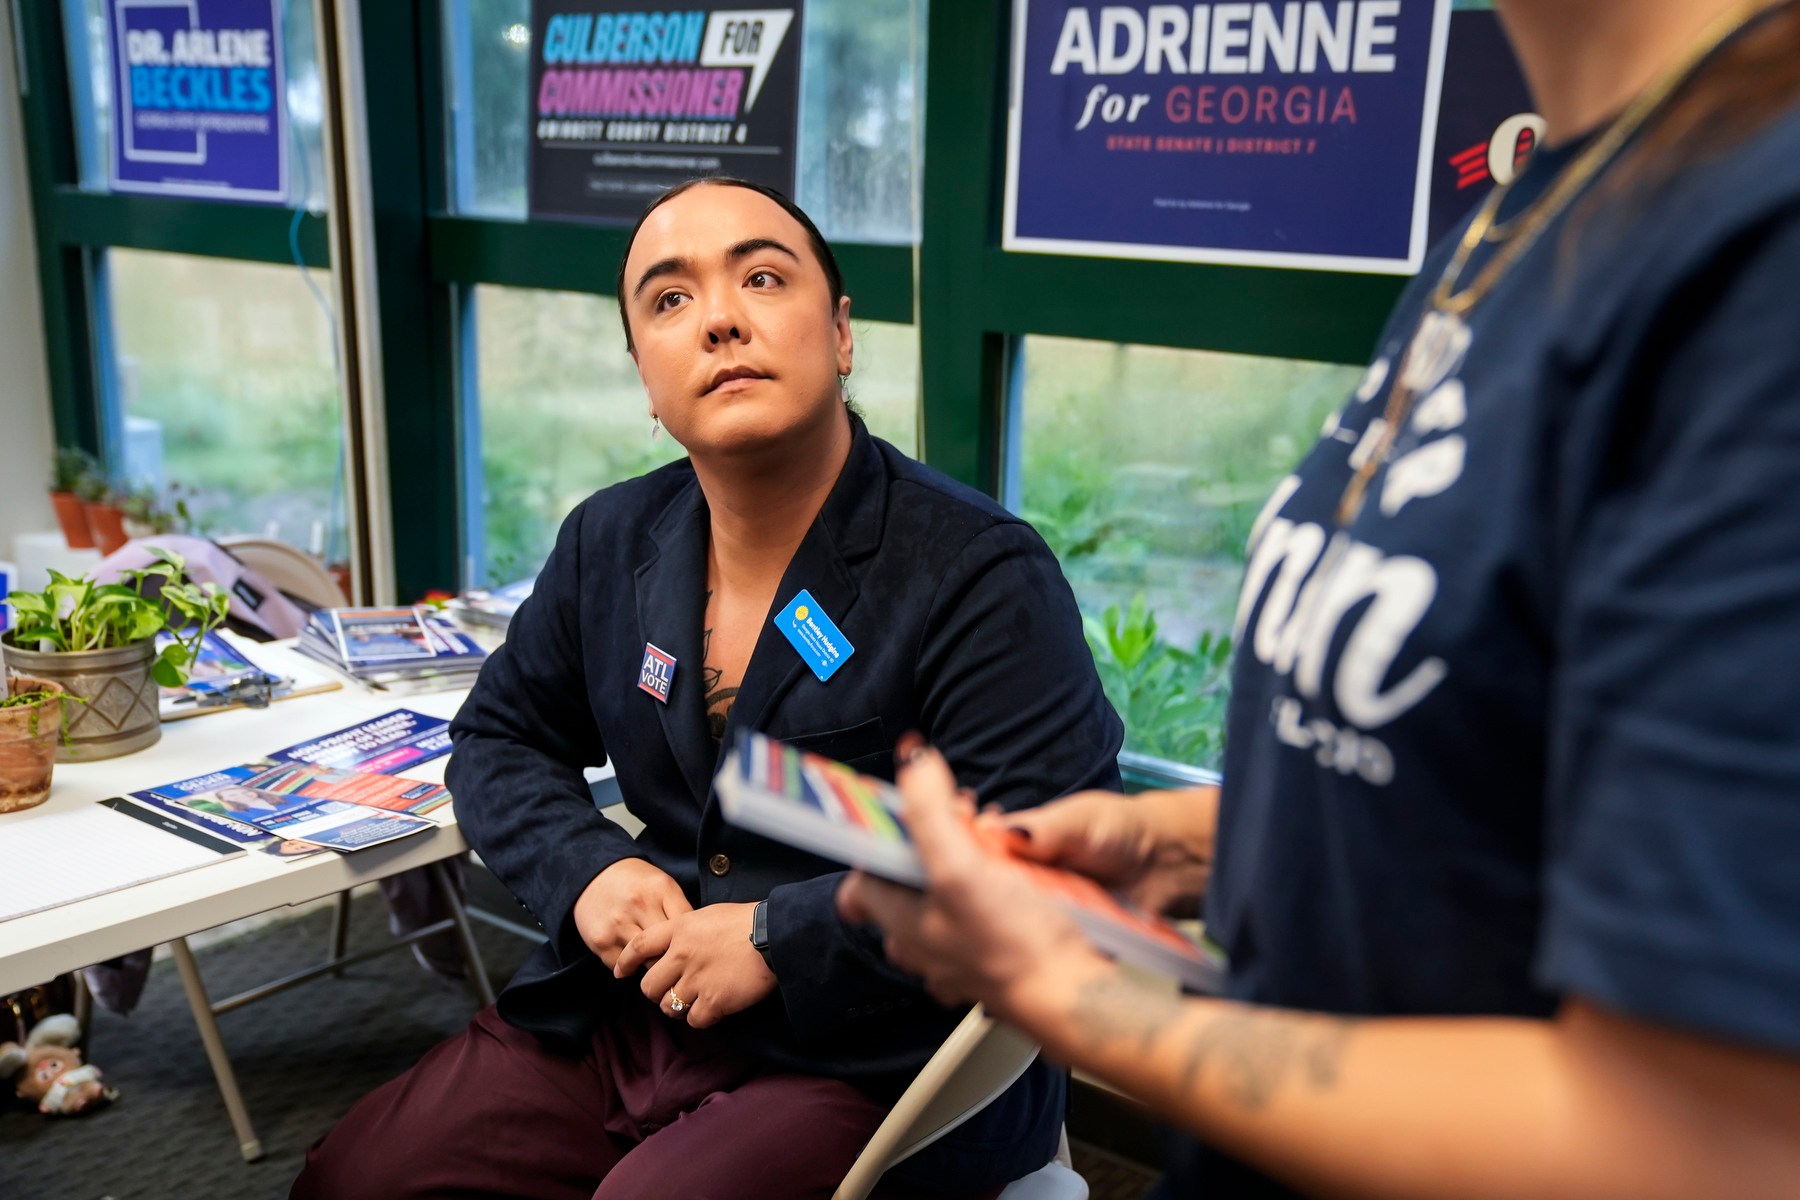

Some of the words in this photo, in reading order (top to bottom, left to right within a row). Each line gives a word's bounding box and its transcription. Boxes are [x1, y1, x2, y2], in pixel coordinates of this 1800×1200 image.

[128, 30, 170, 65] DR.
[173, 30, 270, 66] ARLENE
[543, 11, 705, 62] CULBERSON
[721, 20, 764, 56] FOR
[1050, 0, 1399, 75] ADRIENNE
[132, 67, 271, 111] BECKLES
[539, 69, 744, 118] COMMISSIONER
[1076, 84, 1149, 130] for
[1166, 85, 1358, 126] GEORGIA
[606, 121, 660, 141] COUNTY
[663, 122, 732, 143] DISTRICT
[1107, 135, 1151, 151] STATE
[1156, 136, 1212, 153] SENATE
[1227, 137, 1301, 154] DISTRICT
[1306, 139, 1317, 154] 7
[806, 617, 824, 639] Bentley
[821, 636, 840, 658] Hudgins
[641, 670, 668, 694] VOTE
[643, 655, 668, 682] ATL
